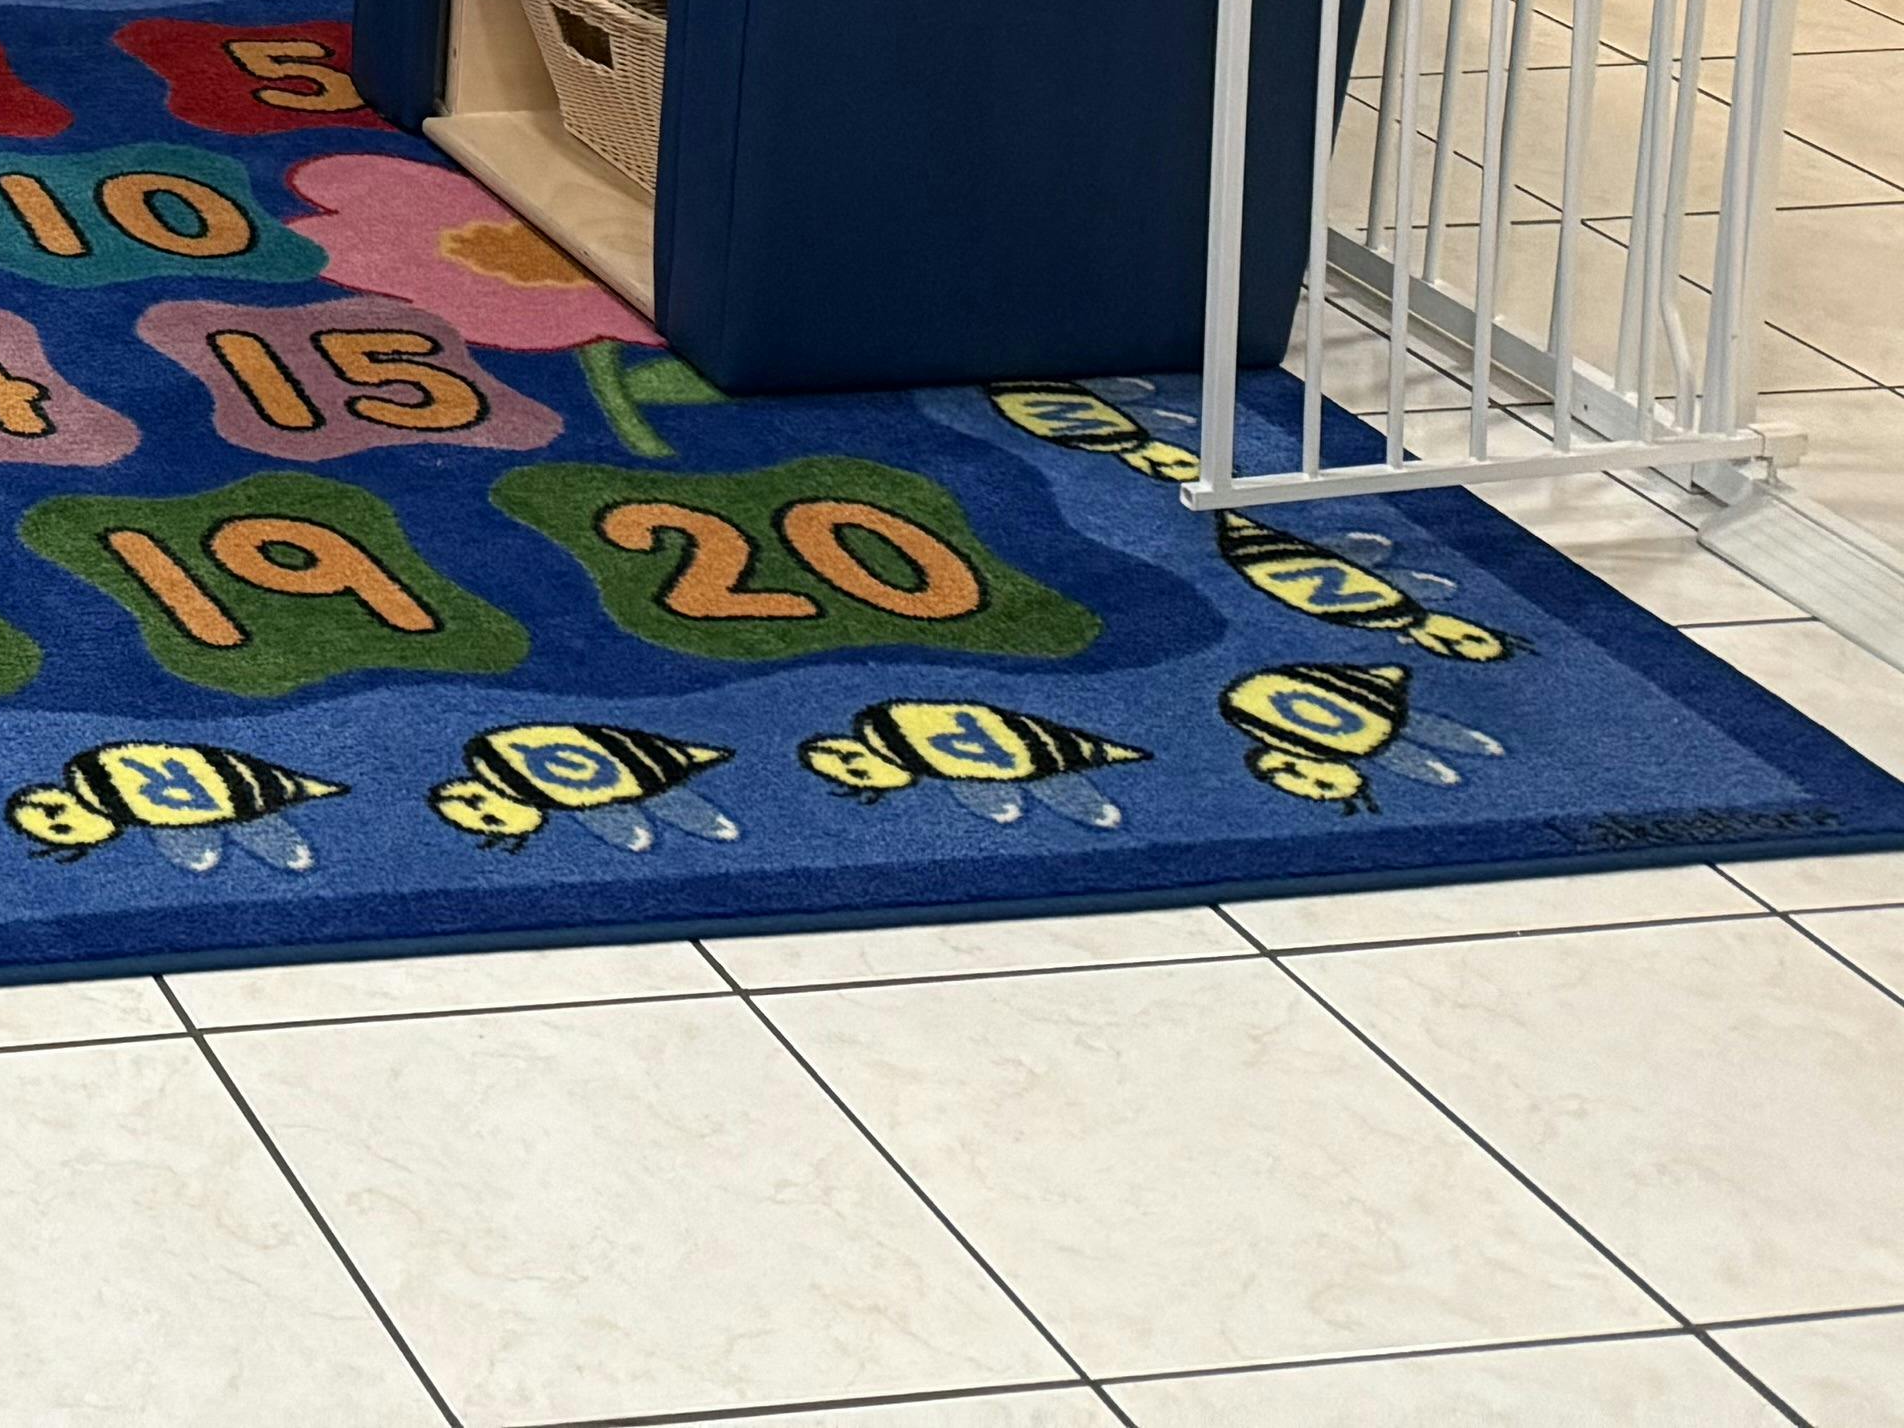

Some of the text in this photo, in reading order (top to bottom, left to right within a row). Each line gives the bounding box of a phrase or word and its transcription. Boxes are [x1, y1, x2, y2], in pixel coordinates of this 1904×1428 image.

[223, 38, 373, 115] 5
[206, 328, 491, 433] 15
[102, 513, 443, 649] 19
[595, 498, 990, 623] 20
[926, 711, 1016, 765] P
[1269, 688, 1363, 739] O
[134, 754, 222, 811] R
